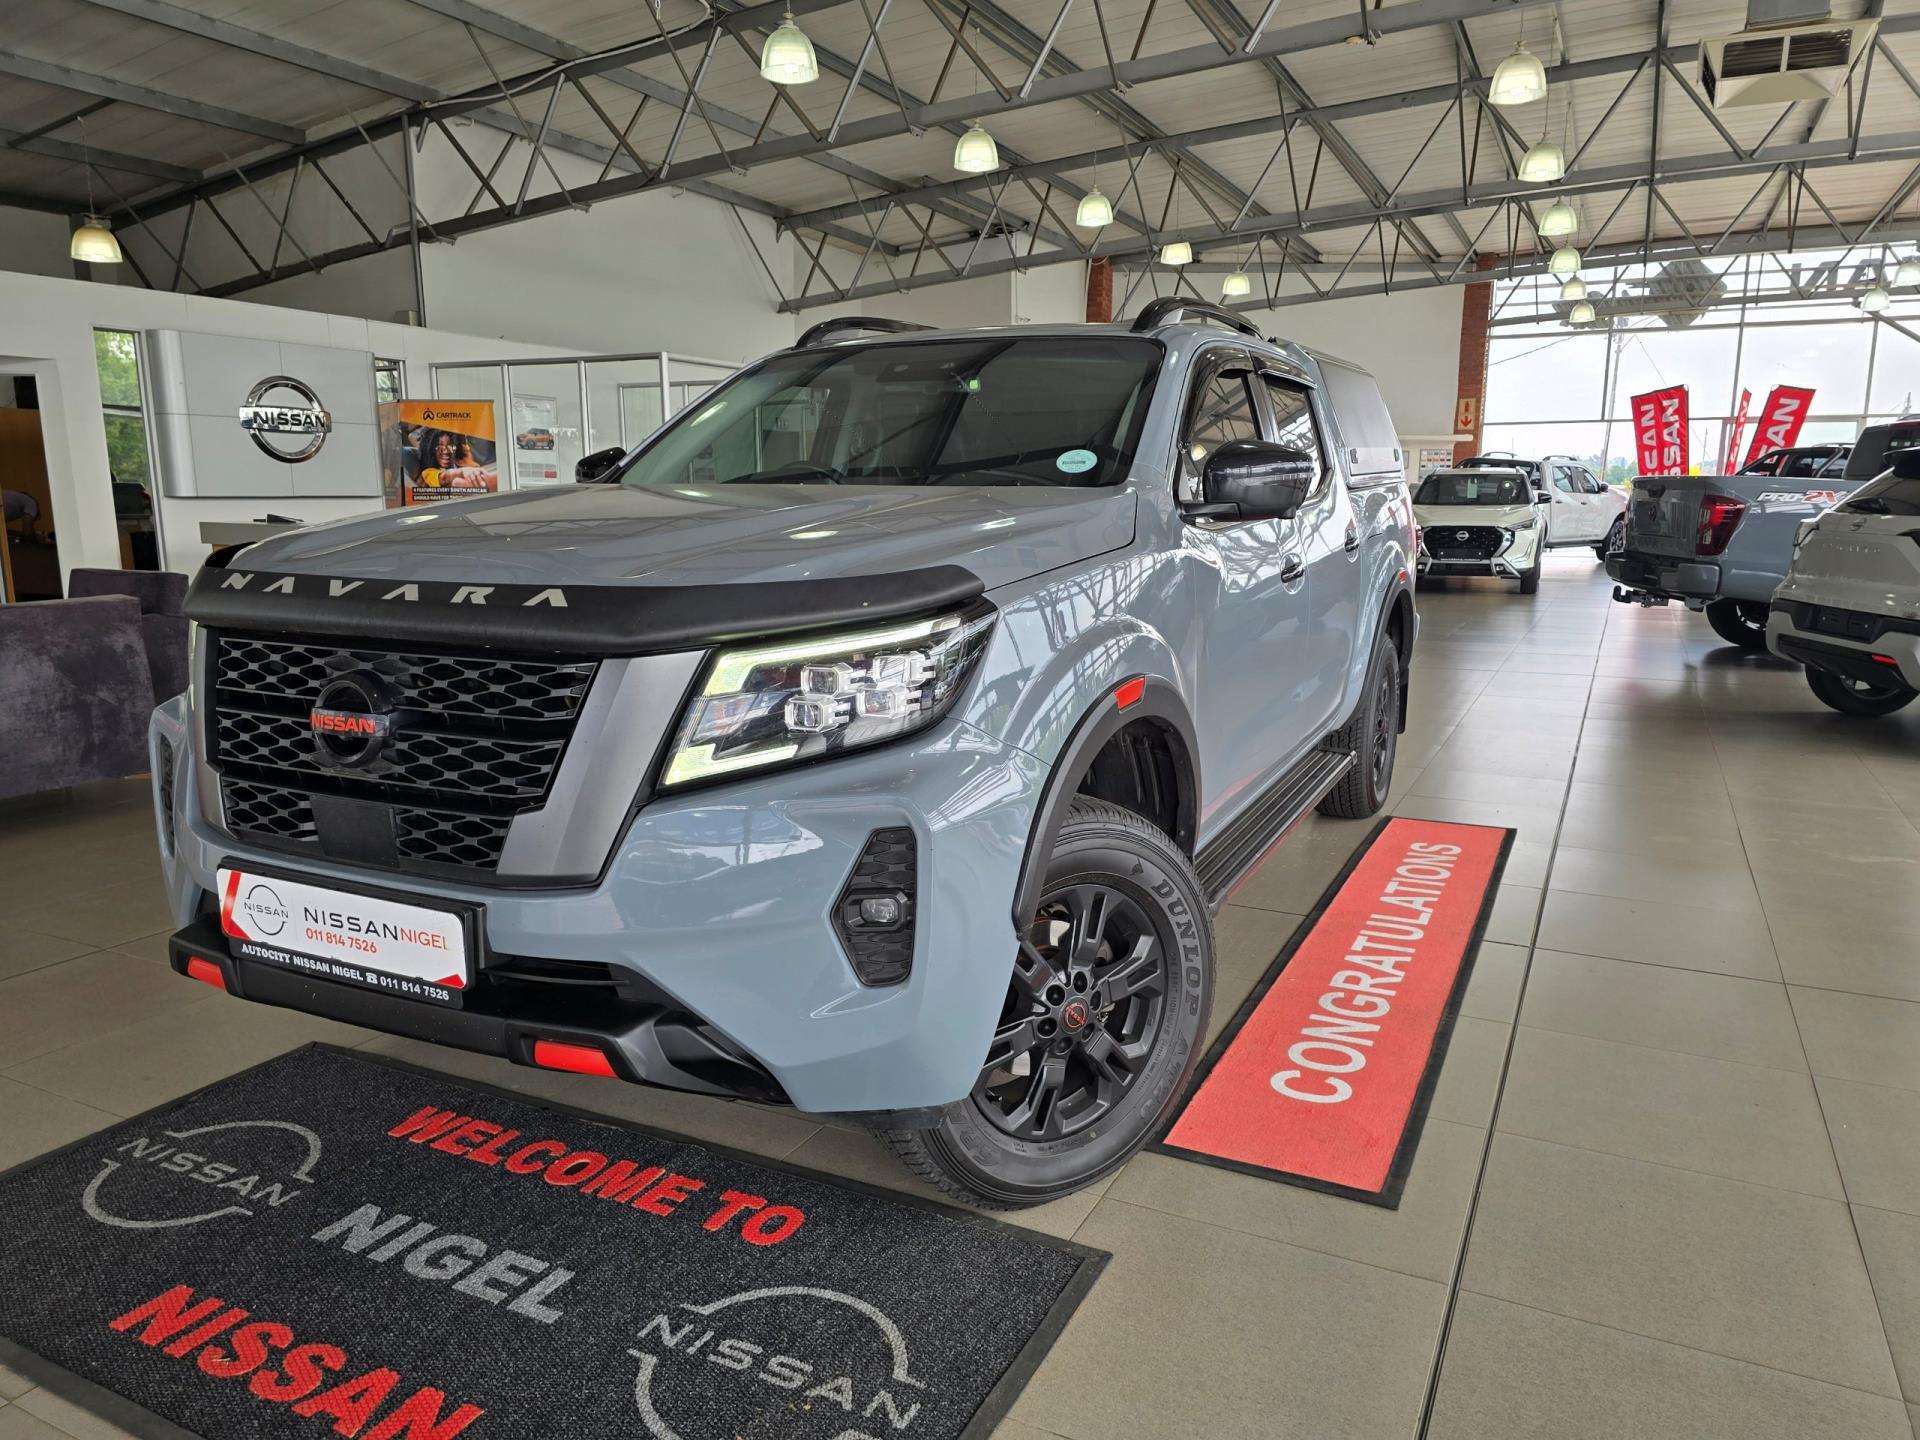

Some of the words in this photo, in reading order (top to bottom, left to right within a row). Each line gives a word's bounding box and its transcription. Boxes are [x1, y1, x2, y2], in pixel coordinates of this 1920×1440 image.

[252, 411, 325, 428] NISSAN
[436, 410, 472, 419] CARTRACK
[221, 573, 568, 607] NAVARA
[310, 713, 376, 734] NISSAN
[244, 902, 289, 919] NISSAN
[306, 928, 323, 942] 011
[326, 931, 345, 947] 814
[348, 937, 377, 953] 7526
[241, 943, 291, 963] AUTOCITY
[293, 955, 331, 973] NISSAN
[332, 965, 364, 981] NIGEL
[380, 976, 398, 989] 011
[402, 982, 421, 994] 814
[423, 985, 449, 1001] 7526
[1151, 879, 1200, 1016] DUNLOP
[1270, 842, 1462, 1103] CONGRATULATIONS
[117, 1137, 300, 1207] NISSAN
[387, 1106, 704, 1217] WELCOME
[703, 1189, 805, 1247] TO
[311, 1203, 575, 1324] NIGEL
[109, 1284, 485, 1440] NISSAN
[637, 1314, 921, 1429] NISSAN
